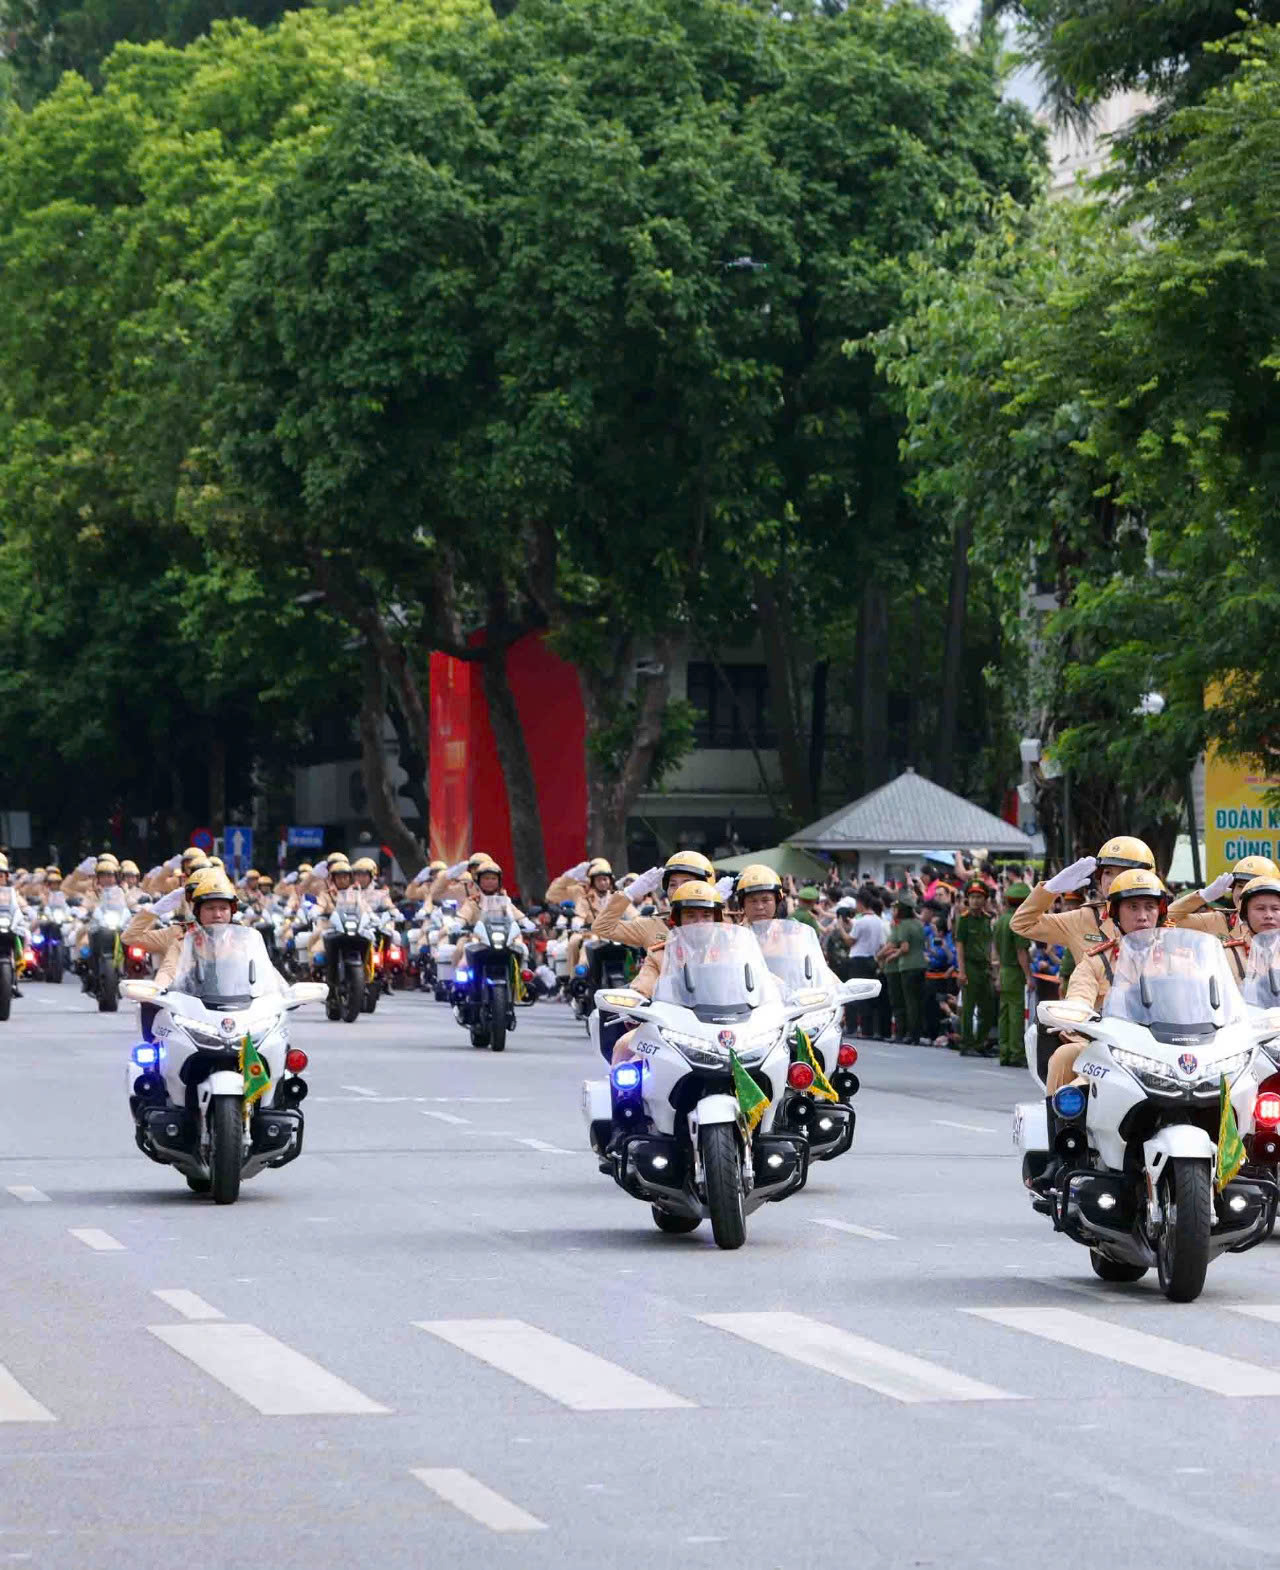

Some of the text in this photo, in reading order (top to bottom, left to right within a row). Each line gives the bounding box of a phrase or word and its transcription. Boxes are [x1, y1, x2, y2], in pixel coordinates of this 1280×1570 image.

[1215, 805, 1263, 830] ĐOÀN
[1225, 836, 1273, 861] CÙNG
[636, 1041, 661, 1056] CSGT
[1082, 1062, 1111, 1079] CSGT
